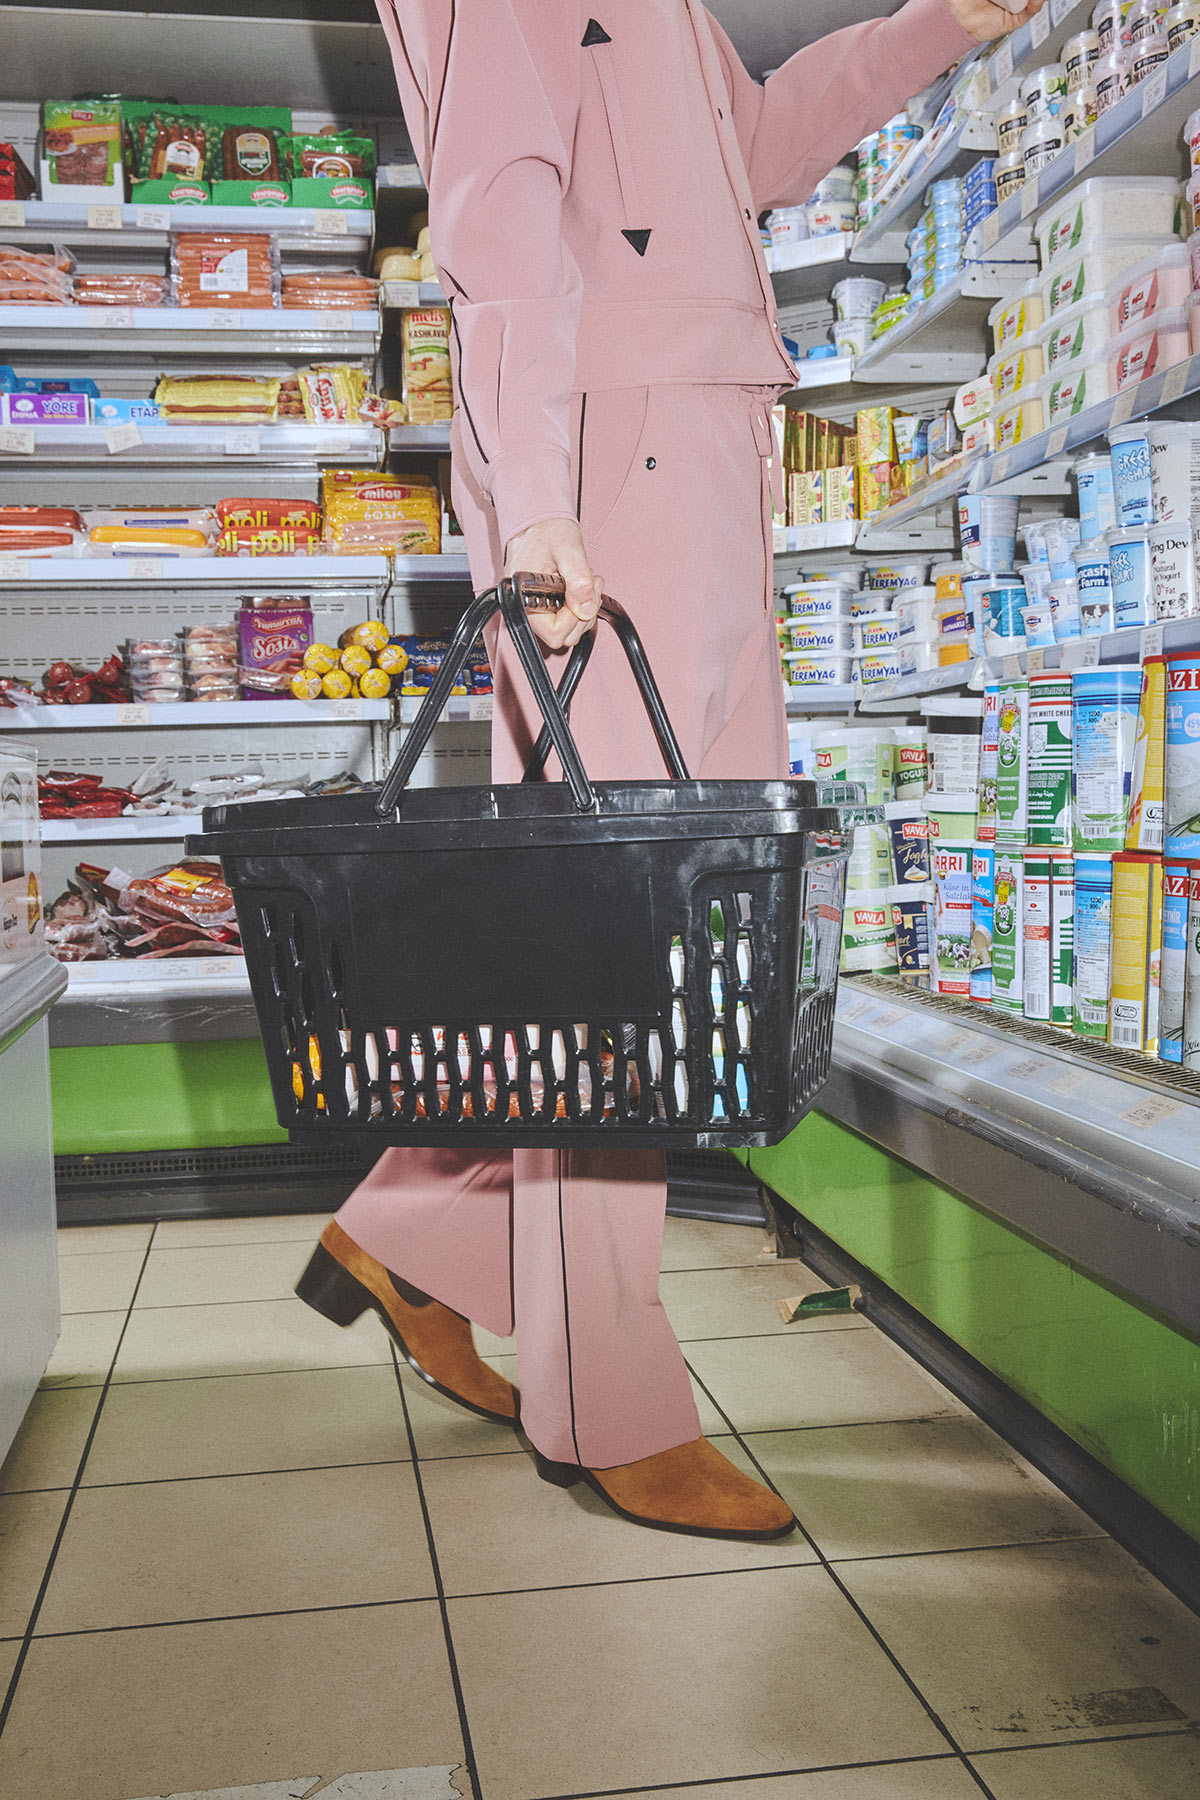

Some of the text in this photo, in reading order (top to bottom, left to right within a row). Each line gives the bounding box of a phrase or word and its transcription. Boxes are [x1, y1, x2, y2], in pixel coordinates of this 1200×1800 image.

[251, 531, 295, 556] poli
[1081, 577, 1105, 590] Farm
[863, 631, 899, 646] TEREMYA
[254, 636, 297, 659] Sosis
[901, 750, 927, 763] YAYLA
[900, 765, 929, 782] YOGUR
[943, 883, 969, 895] Käse in
[856, 910, 885, 925] YAYLA
